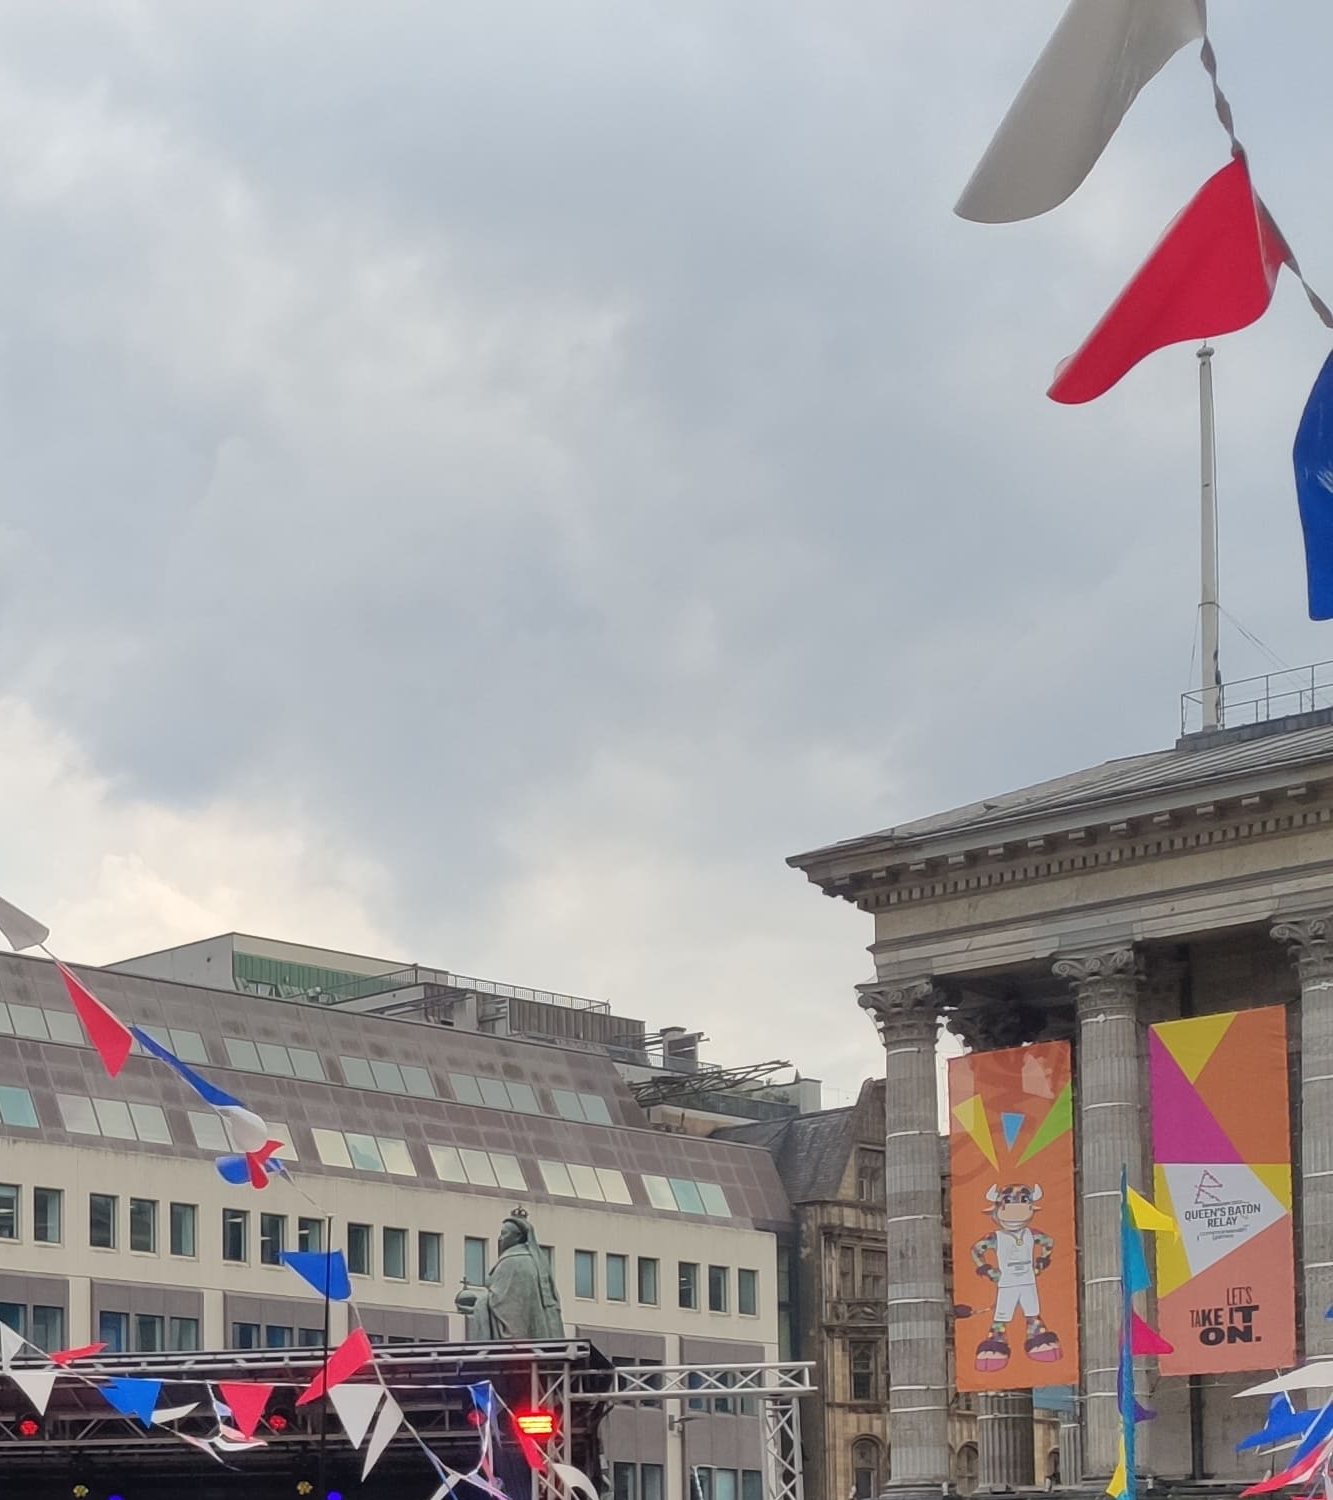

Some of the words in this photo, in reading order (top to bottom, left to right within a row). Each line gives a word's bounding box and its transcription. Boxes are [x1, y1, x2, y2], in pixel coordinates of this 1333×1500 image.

[1184, 1206, 1226, 1221] QUEEN'S
[1228, 1203, 1261, 1216] BATON
[1207, 1216, 1238, 1228] RELAY
[1189, 1308, 1224, 1328] TAKE
[1228, 1305, 1259, 1325] IT
[1199, 1324, 1262, 1346] ON.
